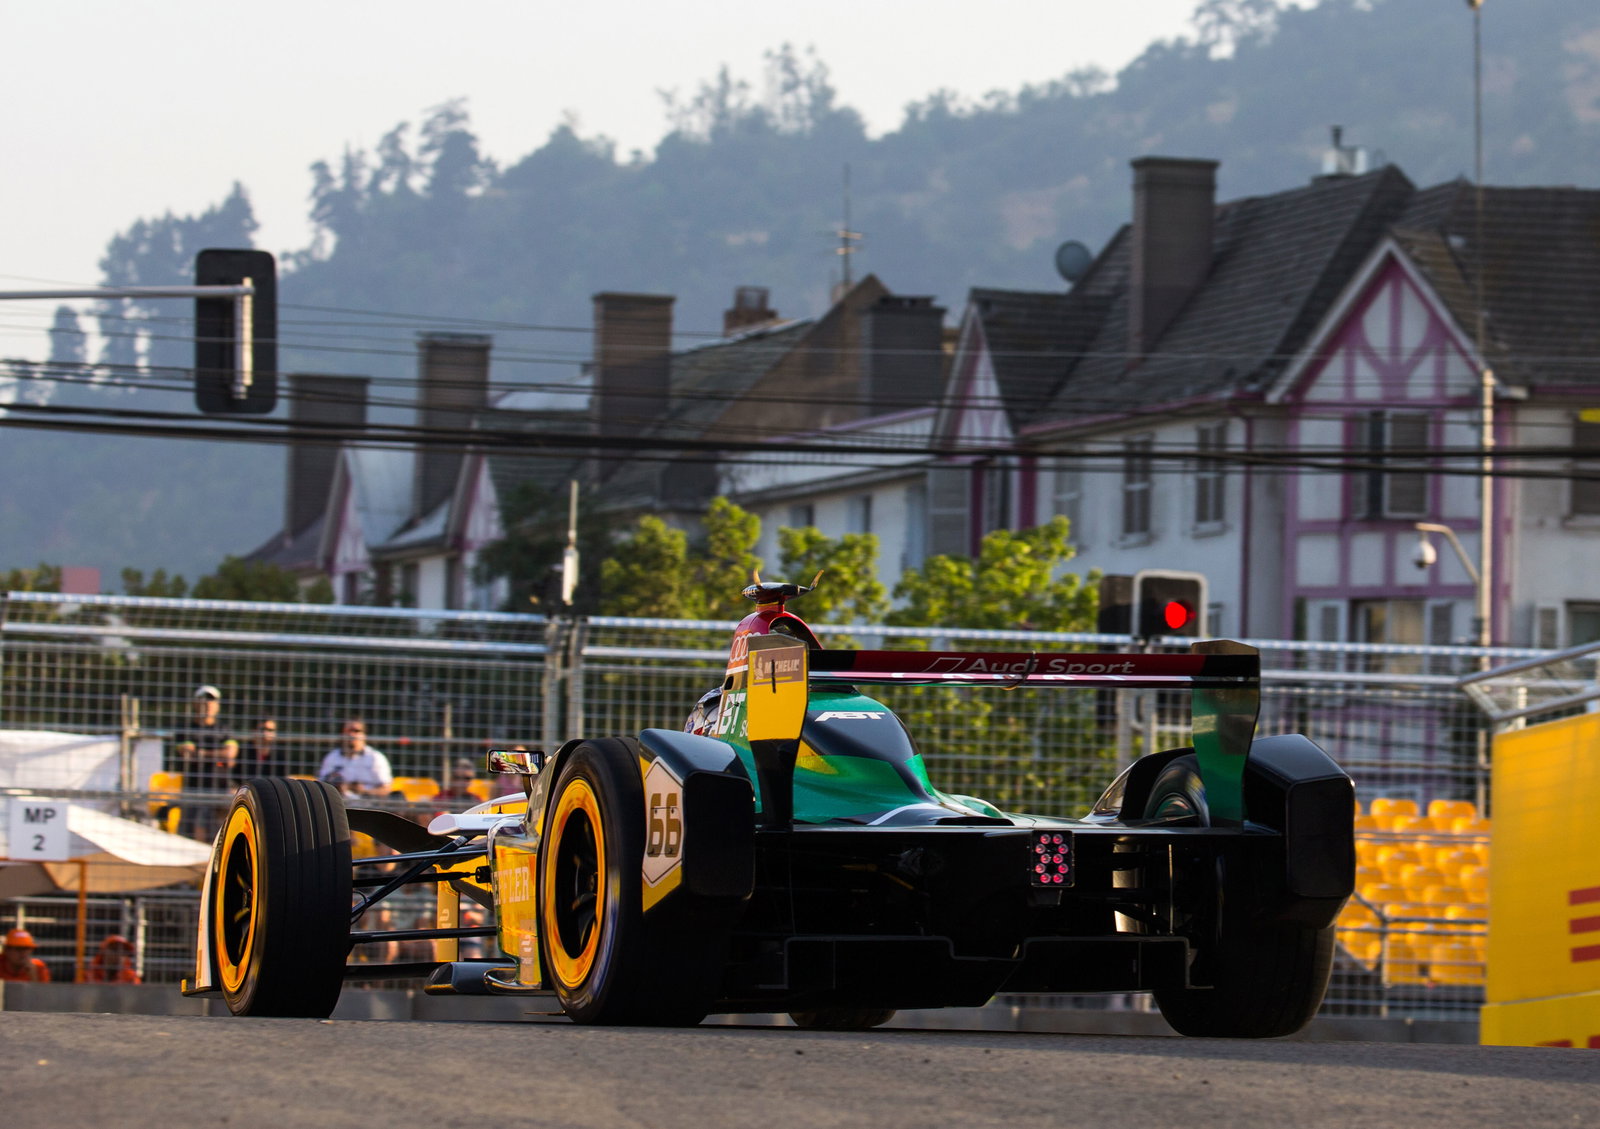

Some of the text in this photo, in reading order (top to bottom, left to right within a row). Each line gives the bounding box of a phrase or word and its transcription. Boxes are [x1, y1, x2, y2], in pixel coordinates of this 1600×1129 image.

[966, 658, 1136, 675] Audi Sport
[815, 711, 885, 722] ABT
[24, 807, 57, 824] MP
[647, 793, 682, 858] 66
[33, 834, 45, 851] 2
